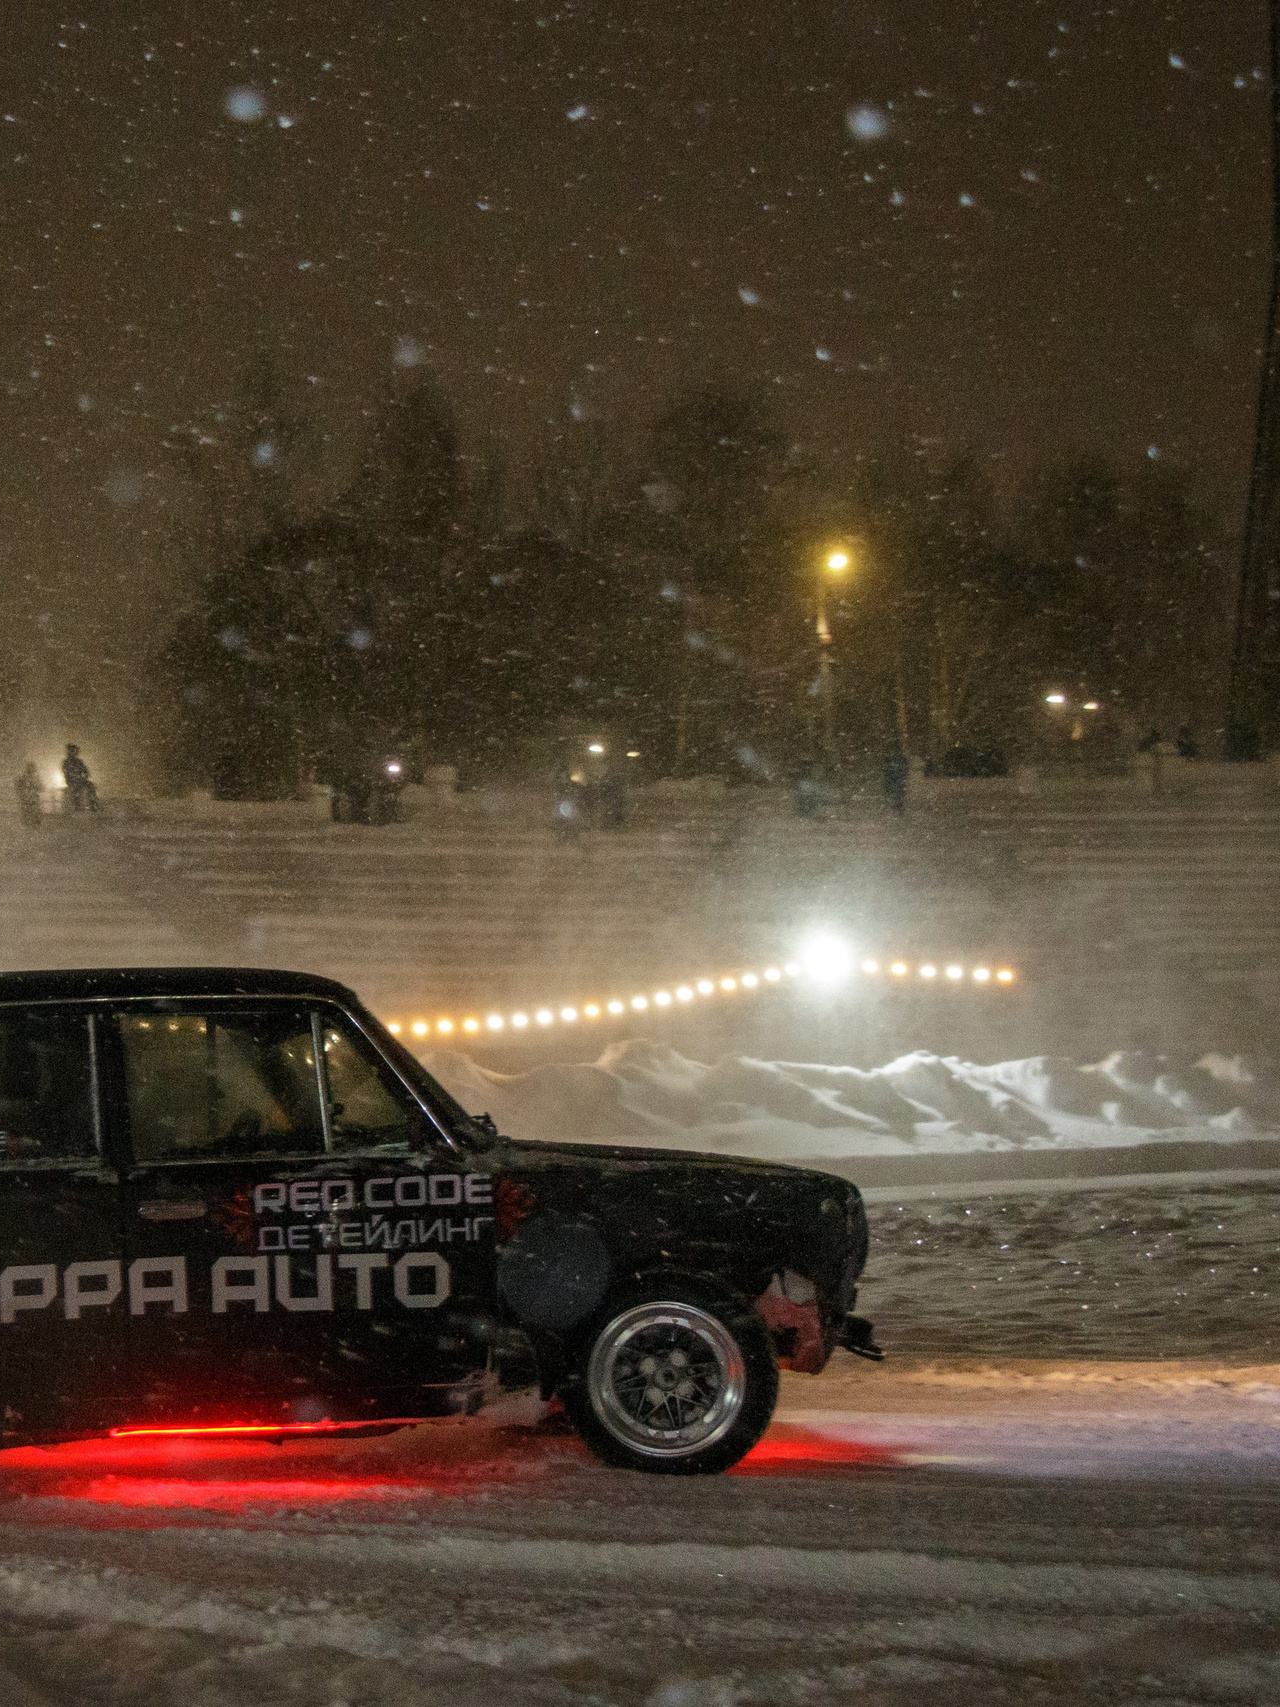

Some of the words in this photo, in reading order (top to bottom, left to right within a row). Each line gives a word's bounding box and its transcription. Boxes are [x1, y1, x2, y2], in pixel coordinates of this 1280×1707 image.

[254, 1179, 355, 1214] RED
[363, 1174, 494, 1208] CODE
[257, 1214, 495, 1251] ДЕТЕЙЛИНГ
[211, 1251, 451, 1314] AUTO
